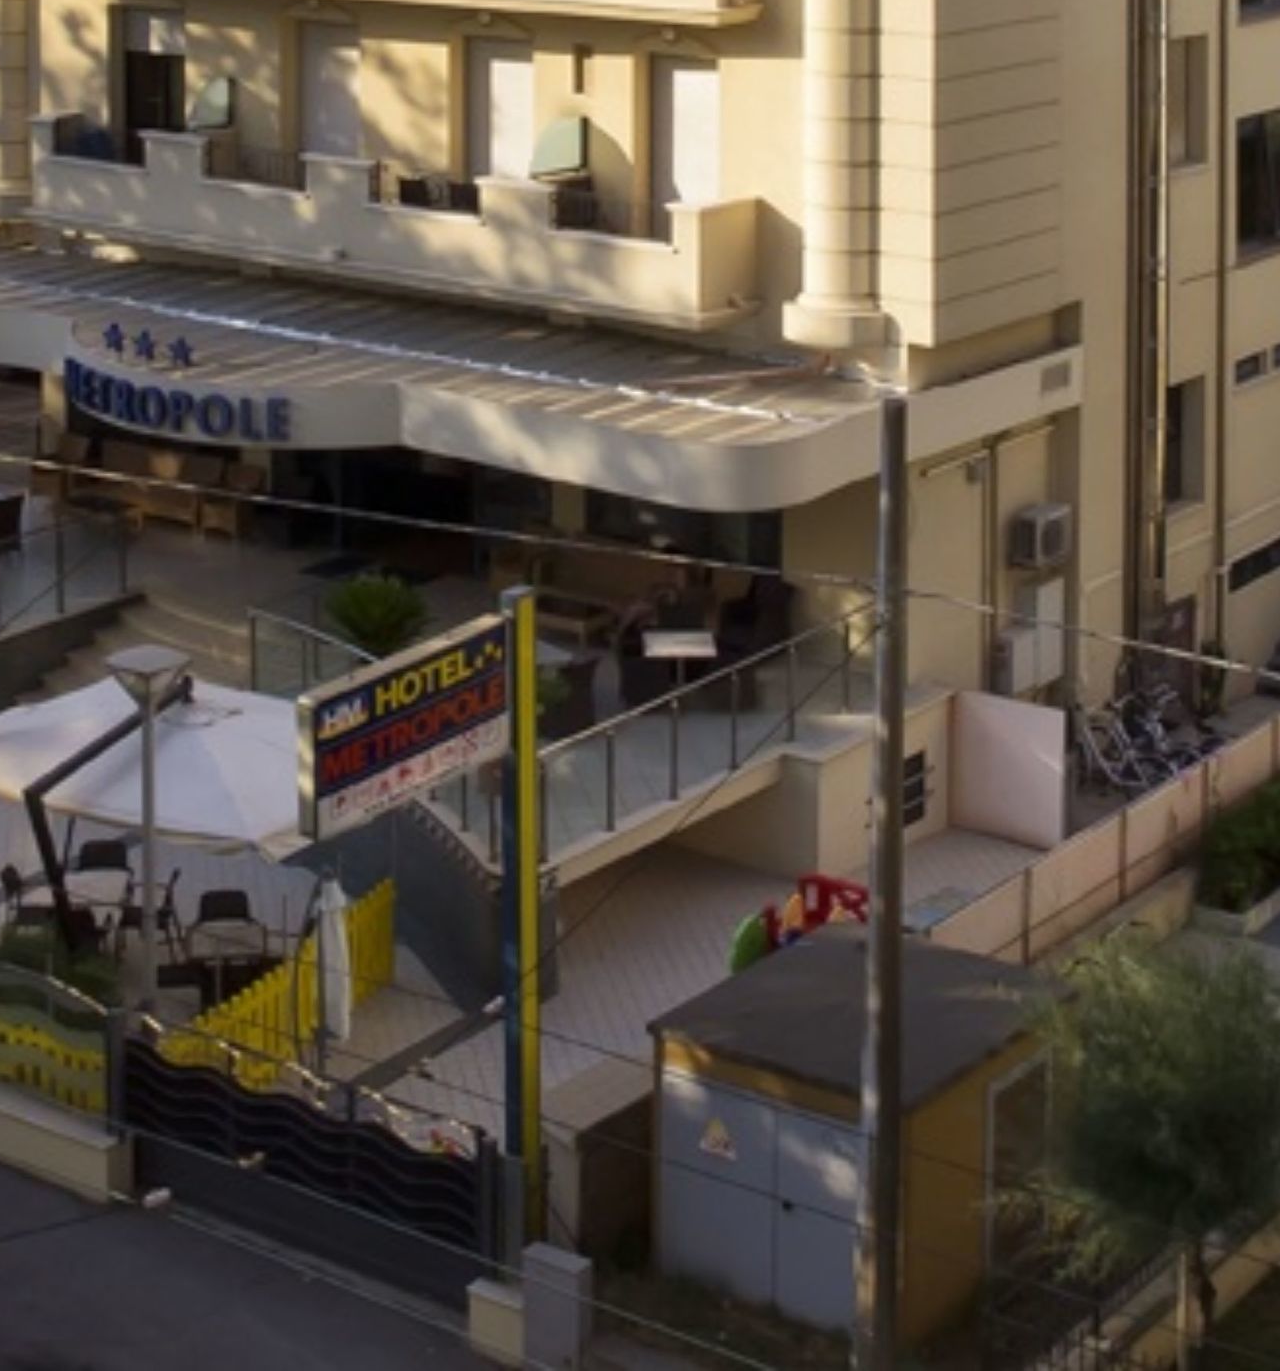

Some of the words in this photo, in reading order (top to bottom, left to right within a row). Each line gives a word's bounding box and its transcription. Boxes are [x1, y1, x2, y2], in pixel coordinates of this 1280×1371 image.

[64, 356, 292, 442] METROPOLE
[376, 649, 473, 715] HOTEL
[321, 671, 504, 788] METROPOLE
